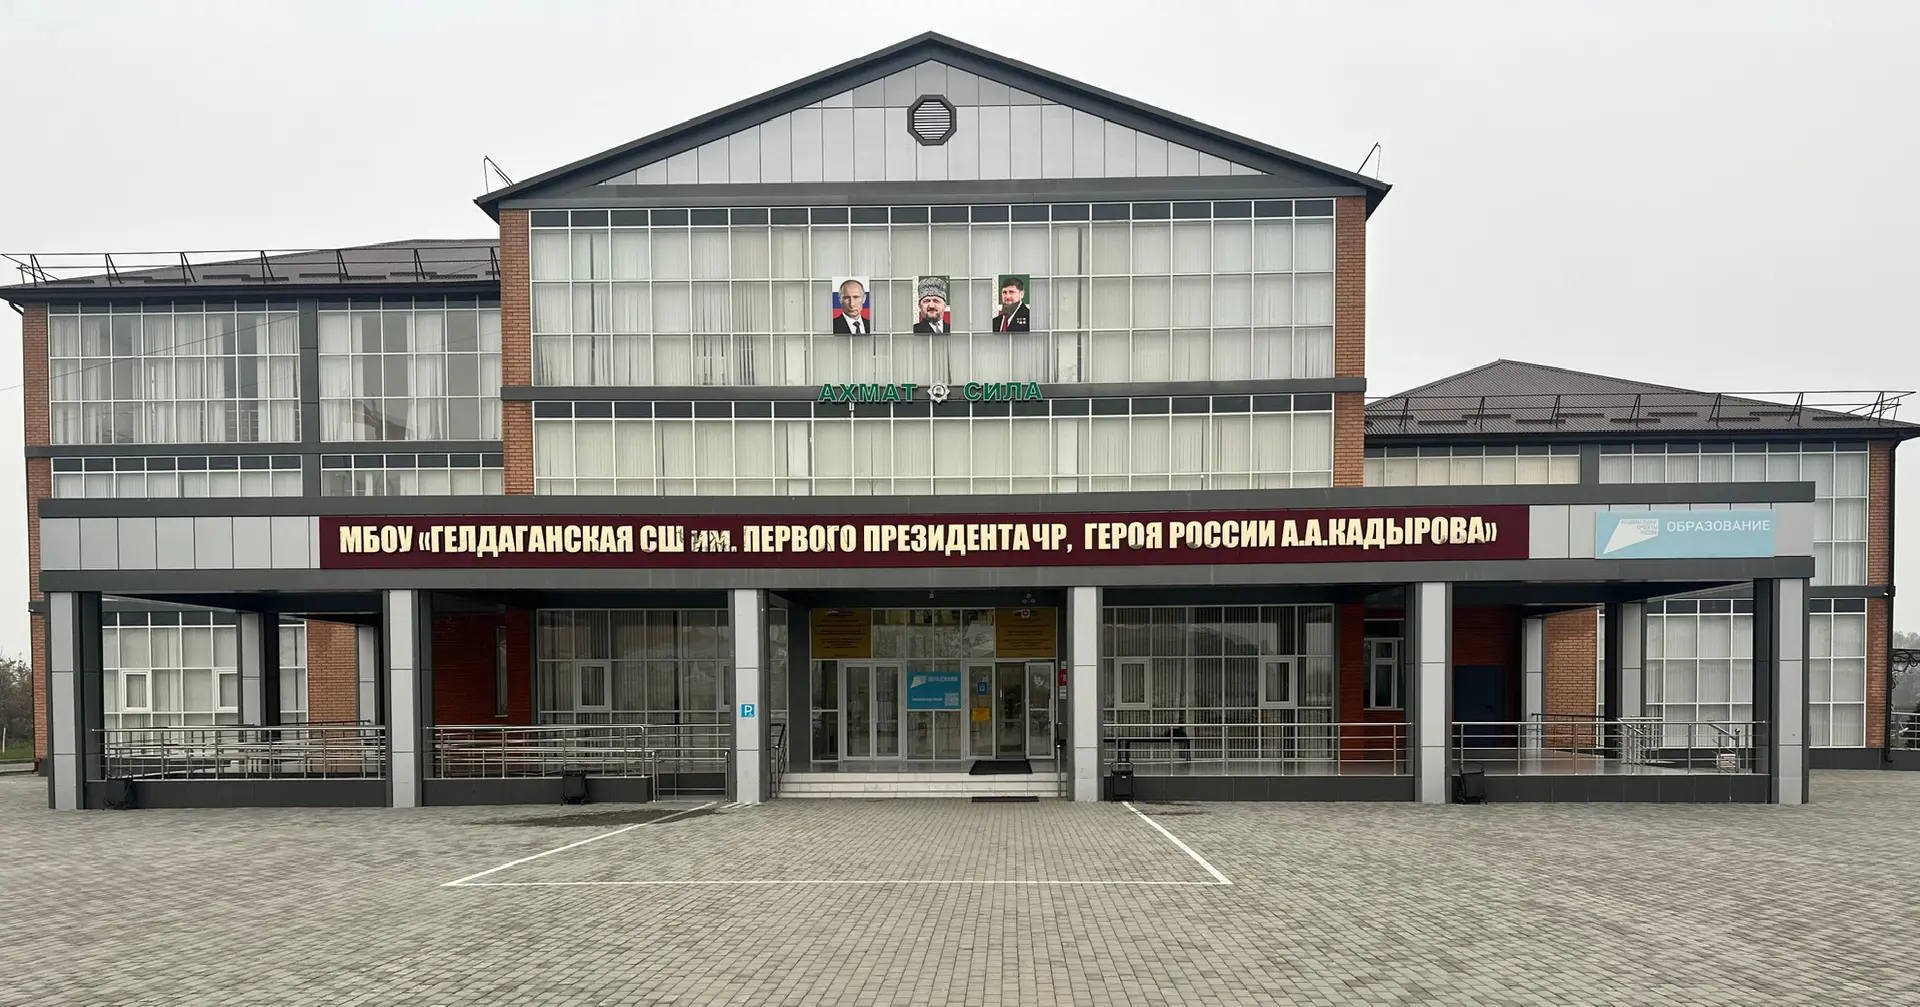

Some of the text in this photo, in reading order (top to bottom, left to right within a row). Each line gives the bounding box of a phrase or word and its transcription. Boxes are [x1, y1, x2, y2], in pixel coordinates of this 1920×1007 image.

[818, 381, 1044, 402] АХМАТ СИЛА
[1666, 519, 1772, 533] ОБРАЗОВАНИЕ
[339, 525, 413, 553] МБОУ
[418, 525, 634, 557] «ГЕЛДАГАНСКАЯ
[639, 525, 685, 553] СШ
[743, 524, 857, 553] ПЕРВОГО
[863, 523, 1031, 557] ПРЕЗИДЕНТА
[1084, 521, 1163, 550] ГЕРОЯ
[1169, 520, 1276, 549] РОССИИ
[744, 704, 753, 717] P
